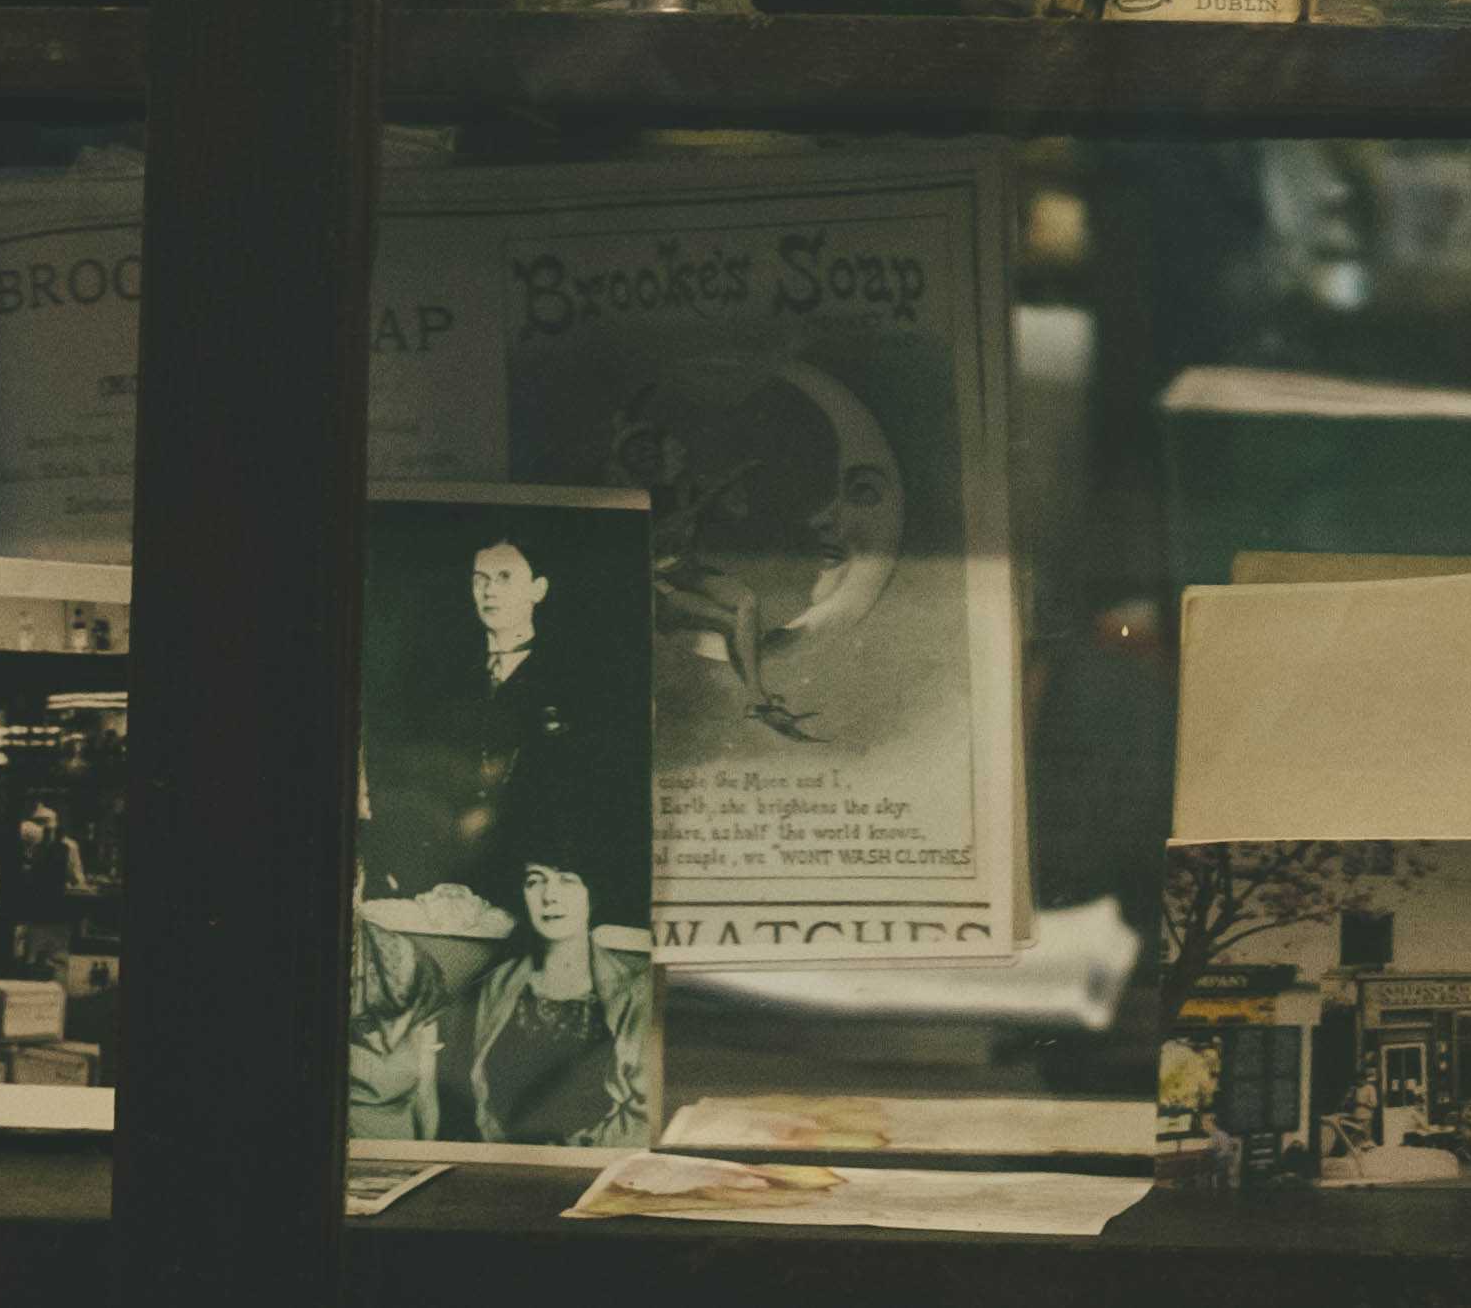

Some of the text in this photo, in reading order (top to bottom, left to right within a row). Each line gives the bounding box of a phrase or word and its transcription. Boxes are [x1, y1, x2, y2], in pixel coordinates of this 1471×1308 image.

[513, 232, 928, 337] Brooke's Soap
[372, 305, 455, 353] AP
[796, 772, 824, 789] and
[756, 797, 837, 820] brightens
[844, 797, 870, 815] the
[779, 824, 806, 841] the
[813, 822, 861, 841] world
[837, 847, 892, 865] WASH
